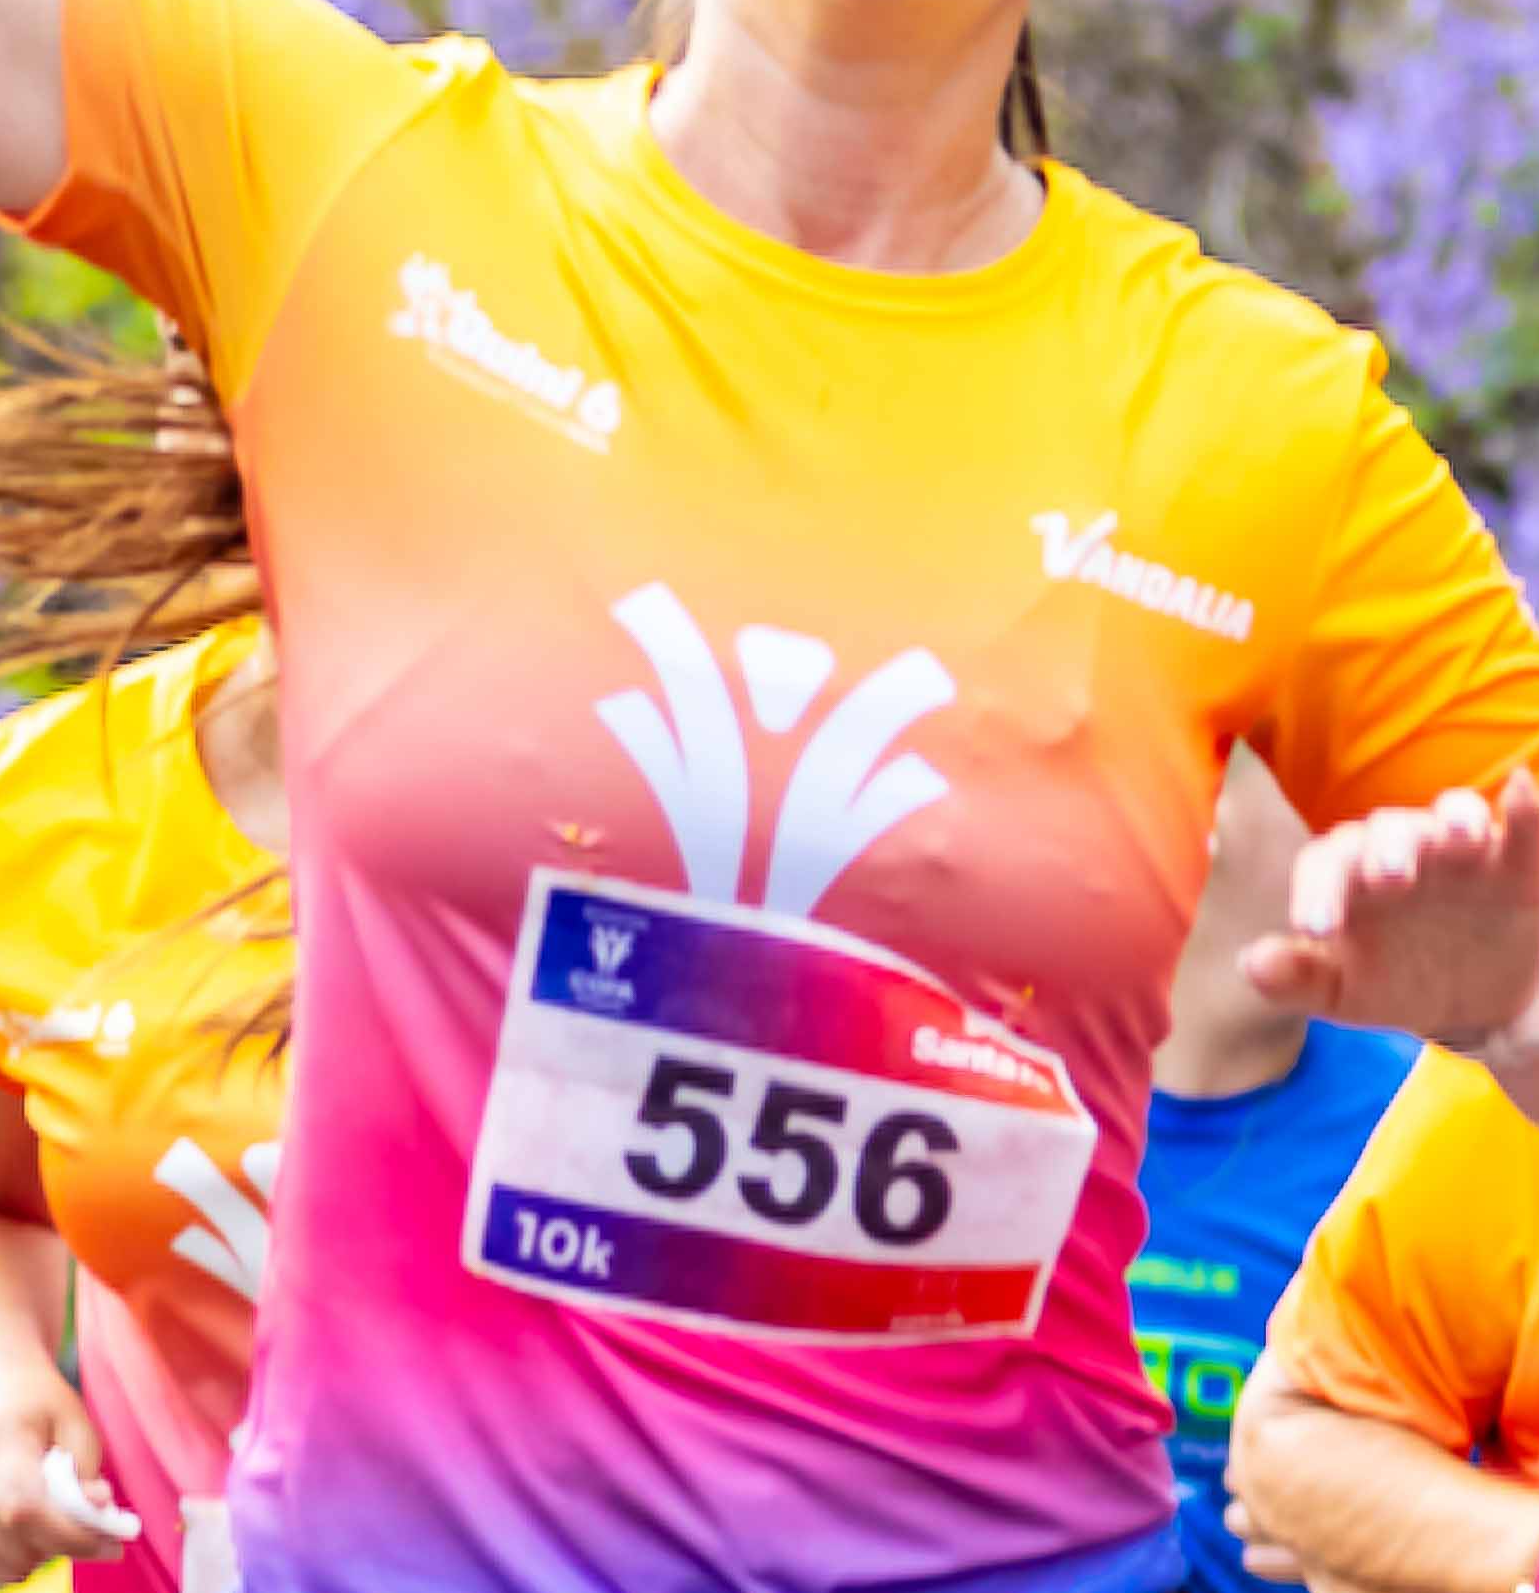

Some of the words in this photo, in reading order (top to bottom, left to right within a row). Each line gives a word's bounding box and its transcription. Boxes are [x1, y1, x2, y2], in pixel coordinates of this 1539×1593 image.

[1028, 508, 1256, 643] VANDALIA
[623, 1052, 960, 1245] 556
[512, 1208, 616, 1279] 10k
